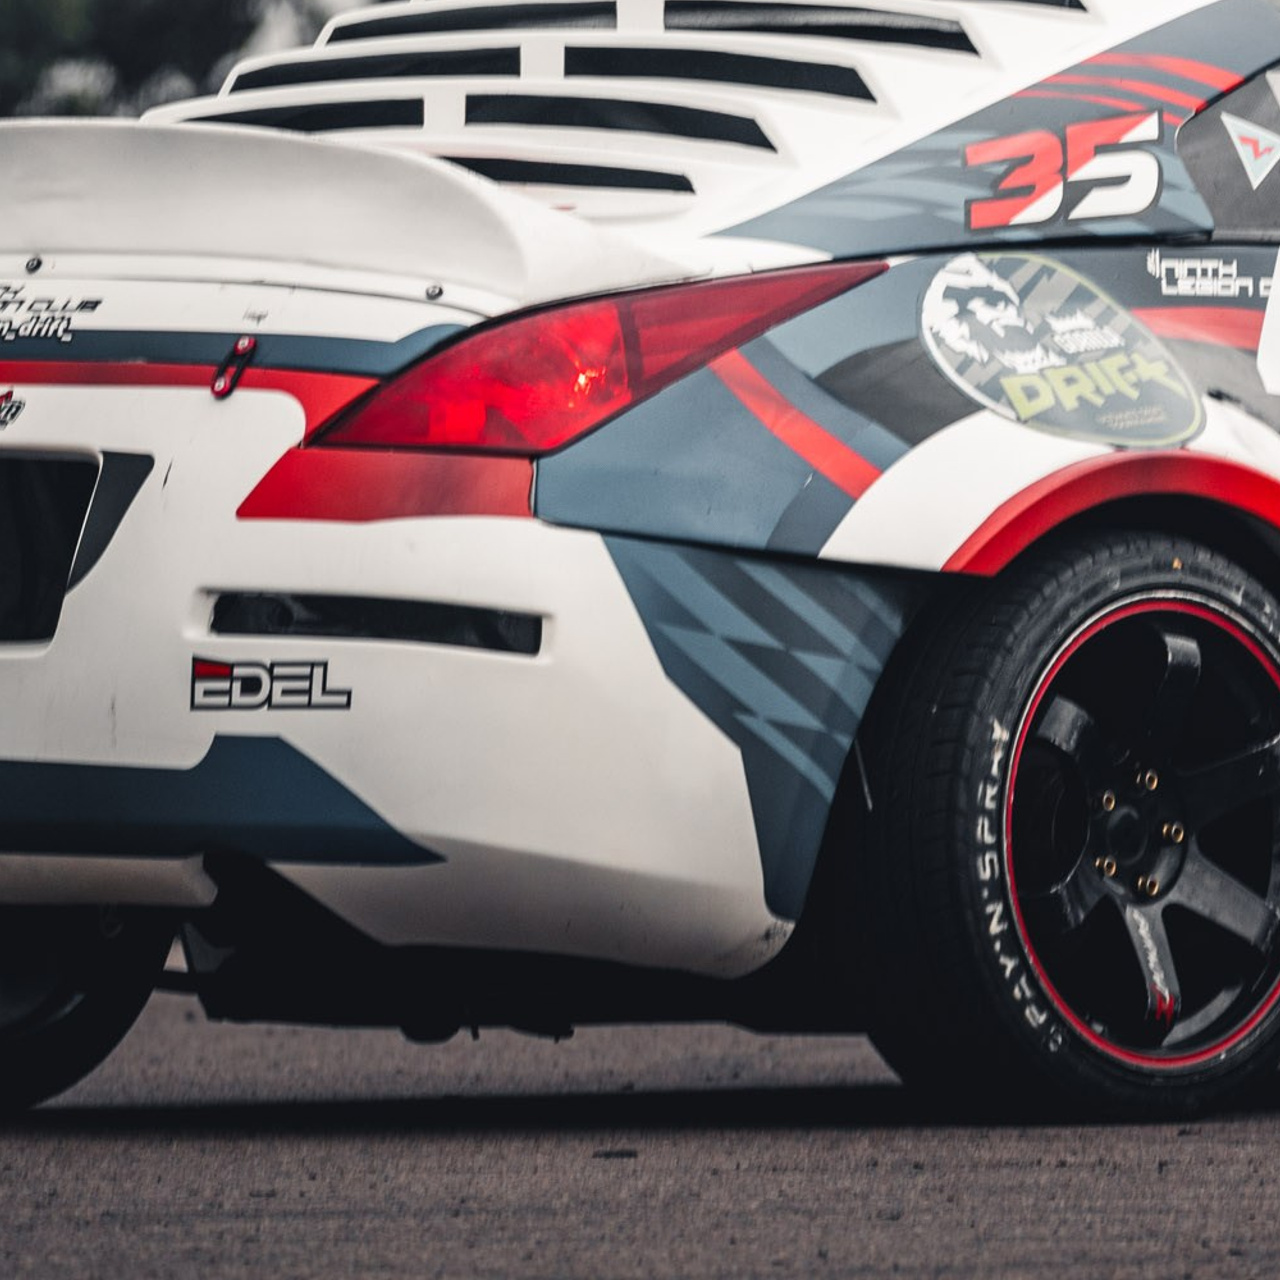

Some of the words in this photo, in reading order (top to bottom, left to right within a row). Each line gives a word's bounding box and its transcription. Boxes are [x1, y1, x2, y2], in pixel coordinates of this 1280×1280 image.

[966, 111, 1160, 229] 35
[1000, 351, 1190, 420] DRIFT
[190, 657, 352, 710] EDEL
